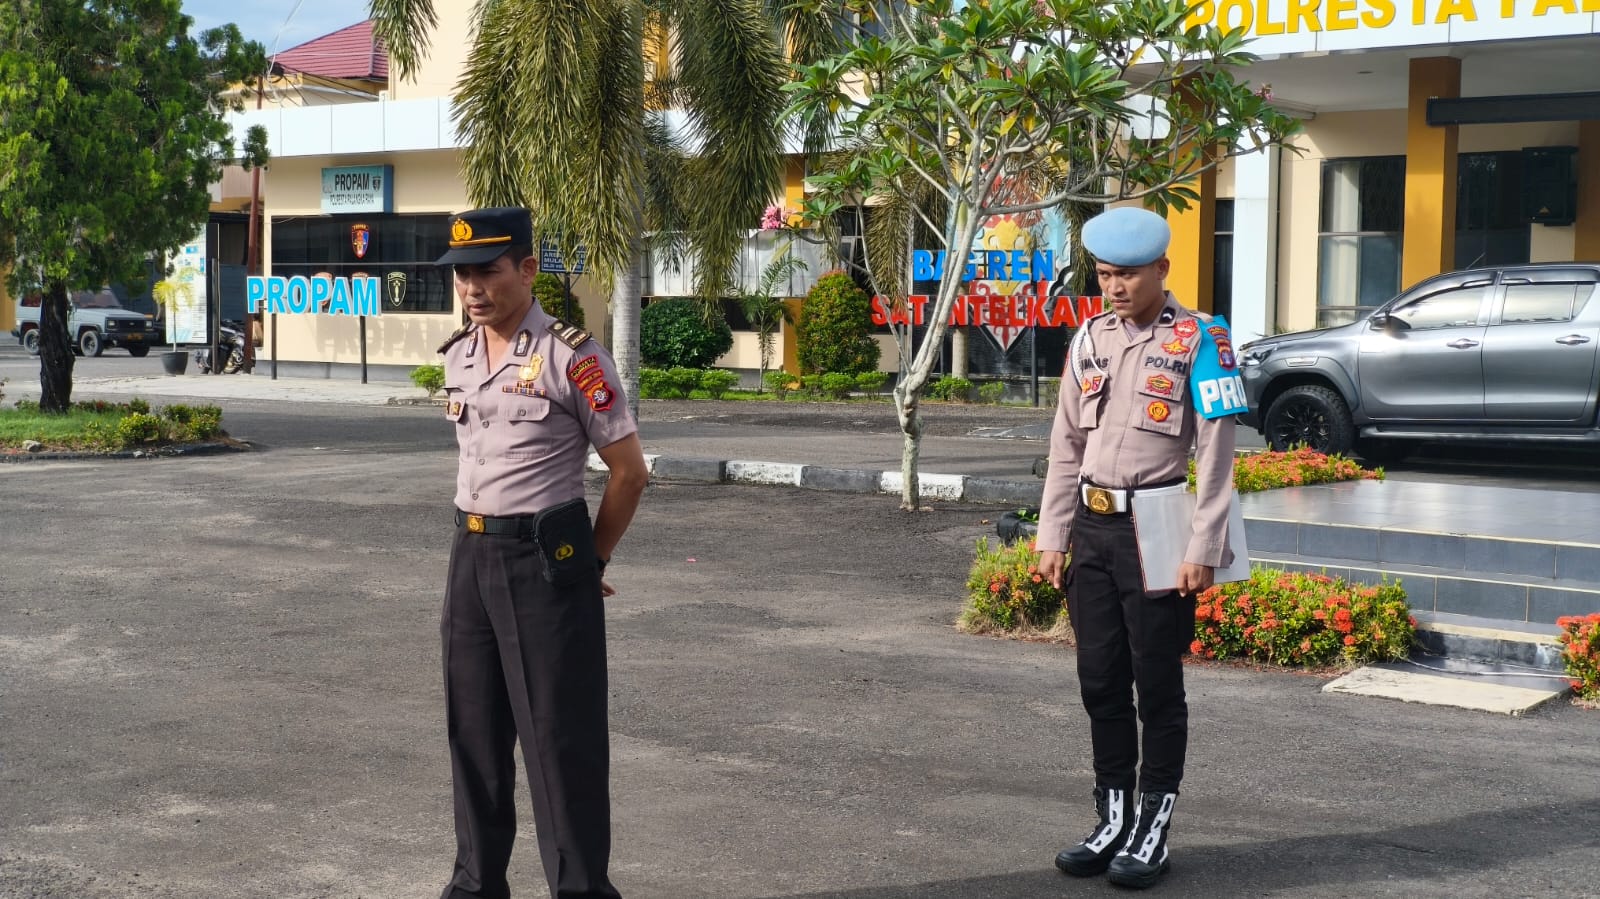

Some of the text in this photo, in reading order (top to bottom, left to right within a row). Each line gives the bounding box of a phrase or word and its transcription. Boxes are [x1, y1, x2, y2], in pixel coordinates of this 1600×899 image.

[334, 173, 370, 191] PROPAM
[987, 249, 1055, 281] REN
[247, 275, 382, 316] PROPAM
[947, 294, 1104, 328] NTELKAM
[1144, 356, 1189, 375] POLRI
